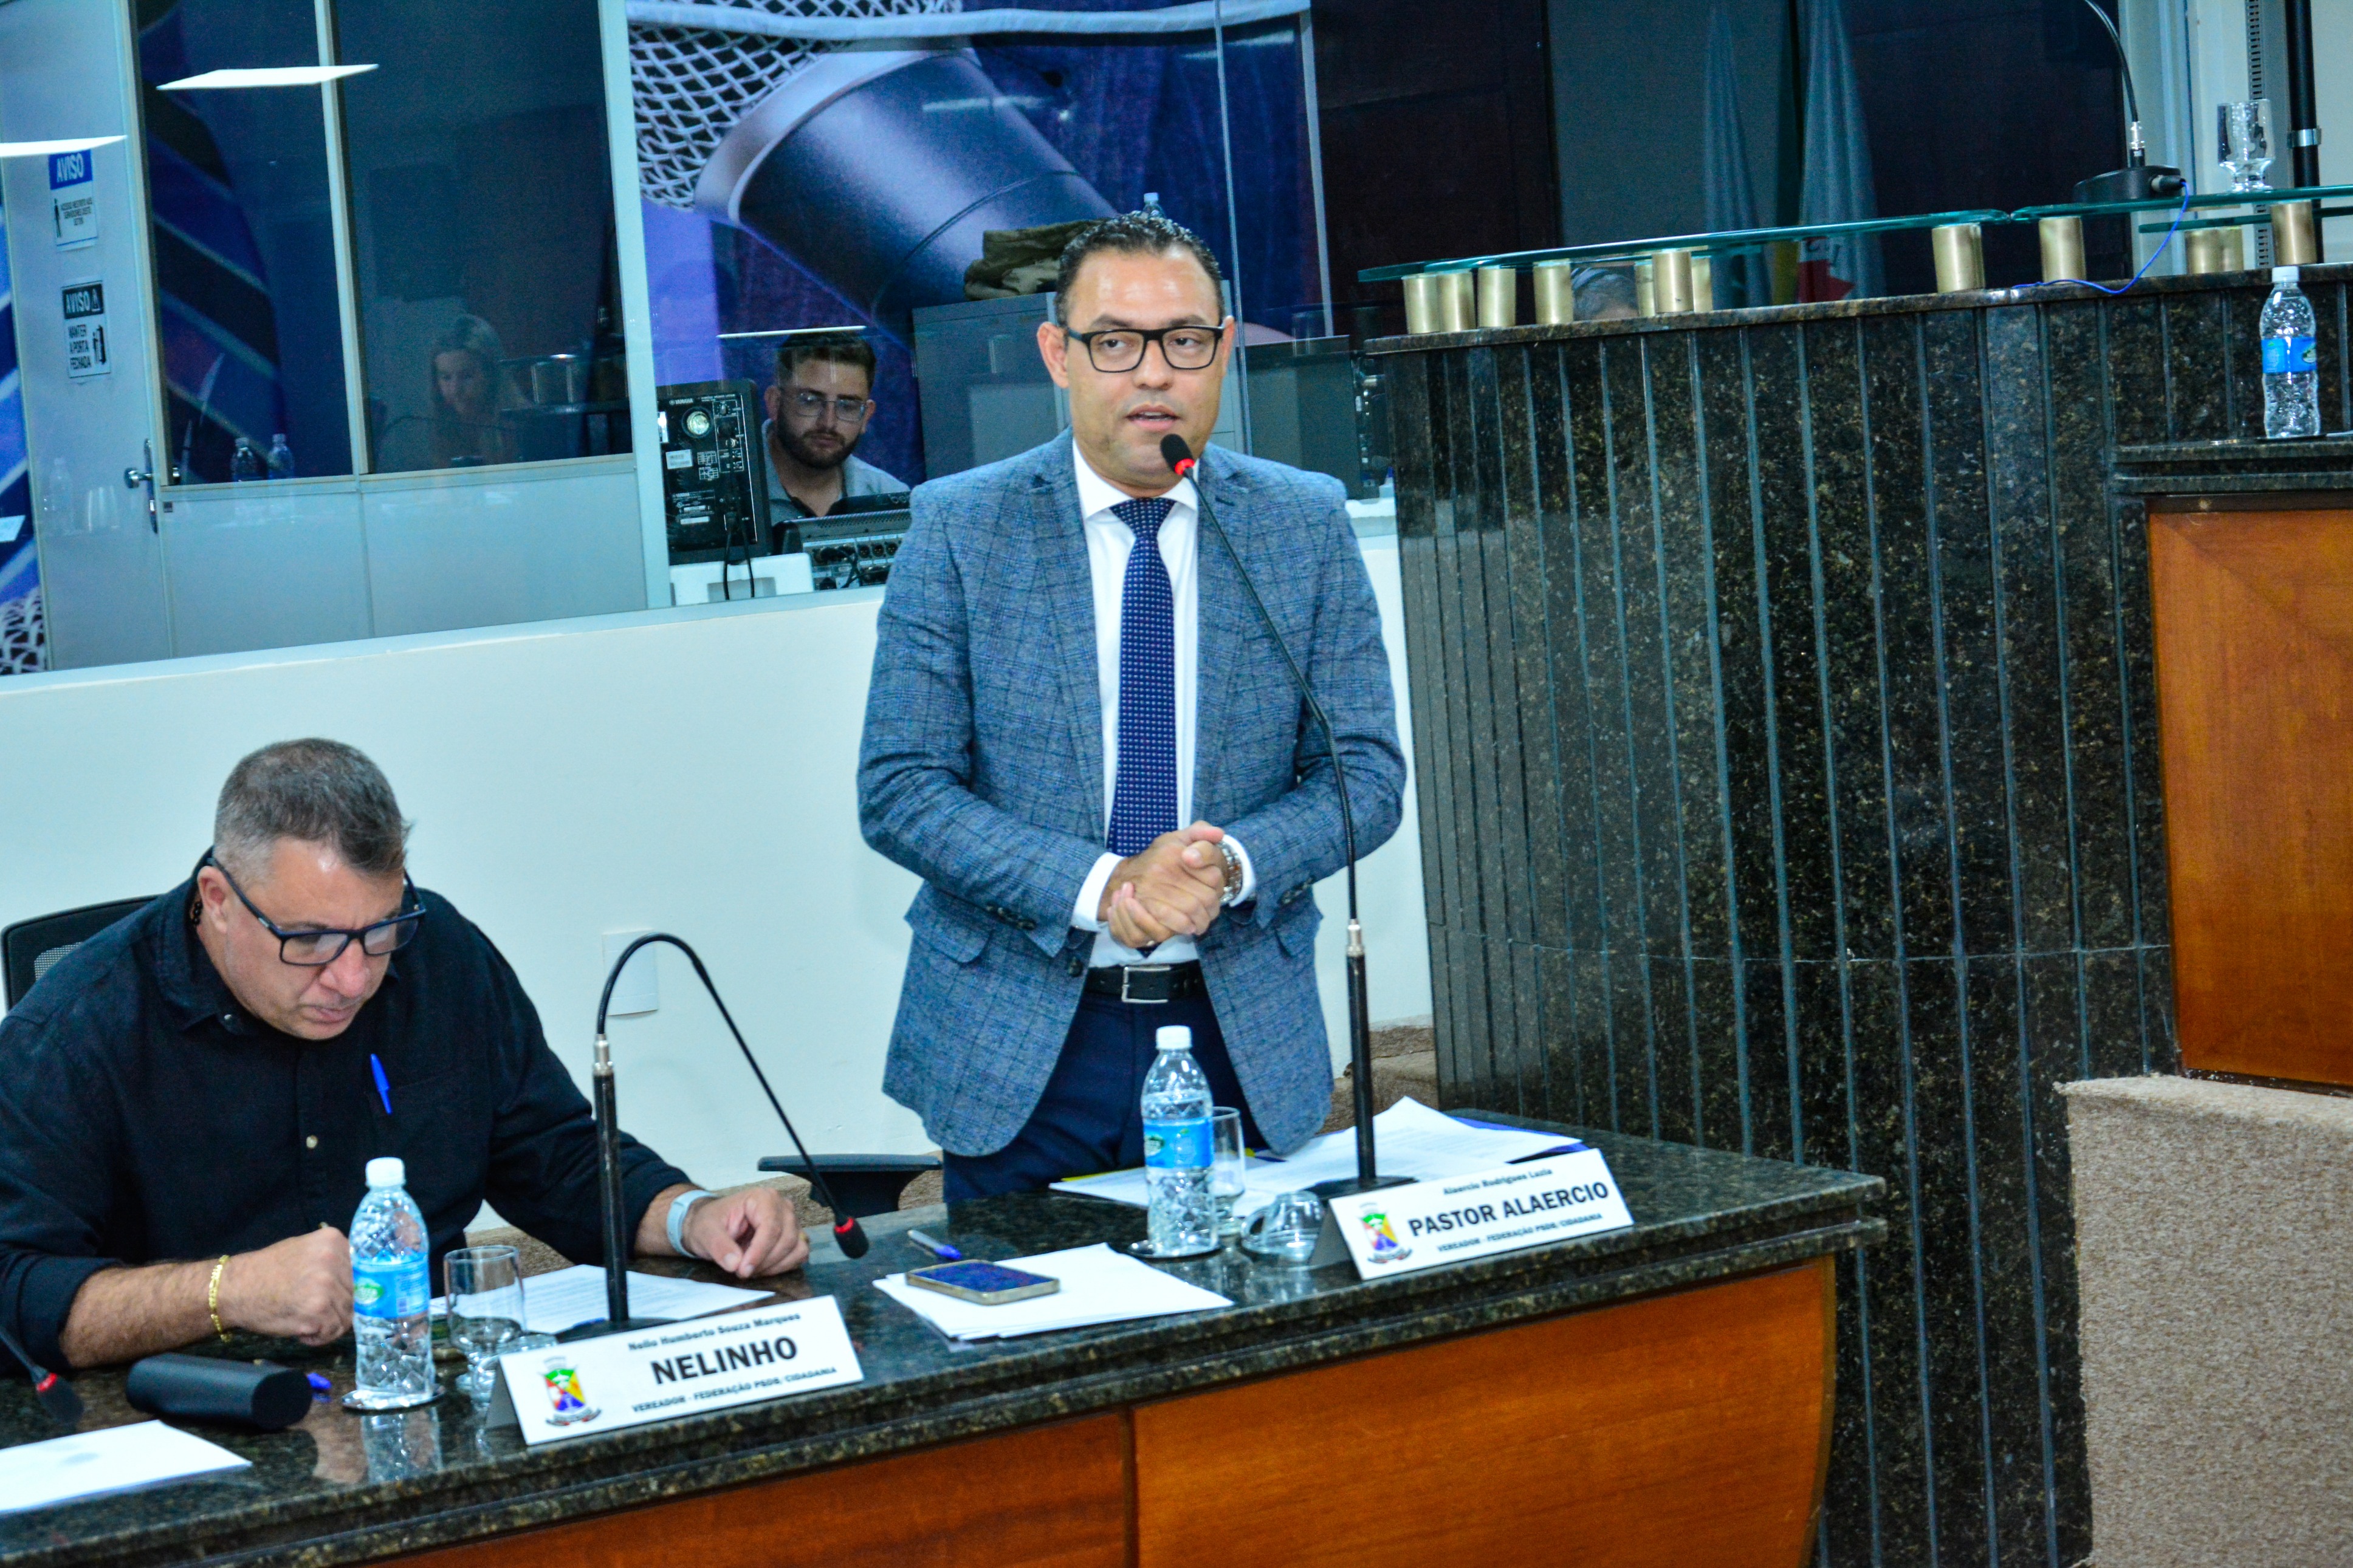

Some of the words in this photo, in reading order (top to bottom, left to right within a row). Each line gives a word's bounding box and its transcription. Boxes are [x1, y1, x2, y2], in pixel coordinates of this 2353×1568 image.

[57, 152, 84, 182] AVISO
[66, 290, 91, 314] AVISO
[68, 324, 86, 338] MANTER
[1481, 1174, 1527, 1187] Rodrigues
[1408, 1205, 1497, 1236] PASTOR
[1502, 1182, 1609, 1218] ALAERCIO
[1437, 1238, 1480, 1252] VEREADOR
[1486, 1225, 1533, 1242] FEDERAÇÃO
[660, 1329, 715, 1344] Humberto
[718, 1323, 751, 1333] Souza
[753, 1313, 801, 1326] Marques
[650, 1336, 797, 1385] NELINHO
[631, 1395, 685, 1412] VEREADOR
[693, 1380, 751, 1400] FEDERAÇÃO
